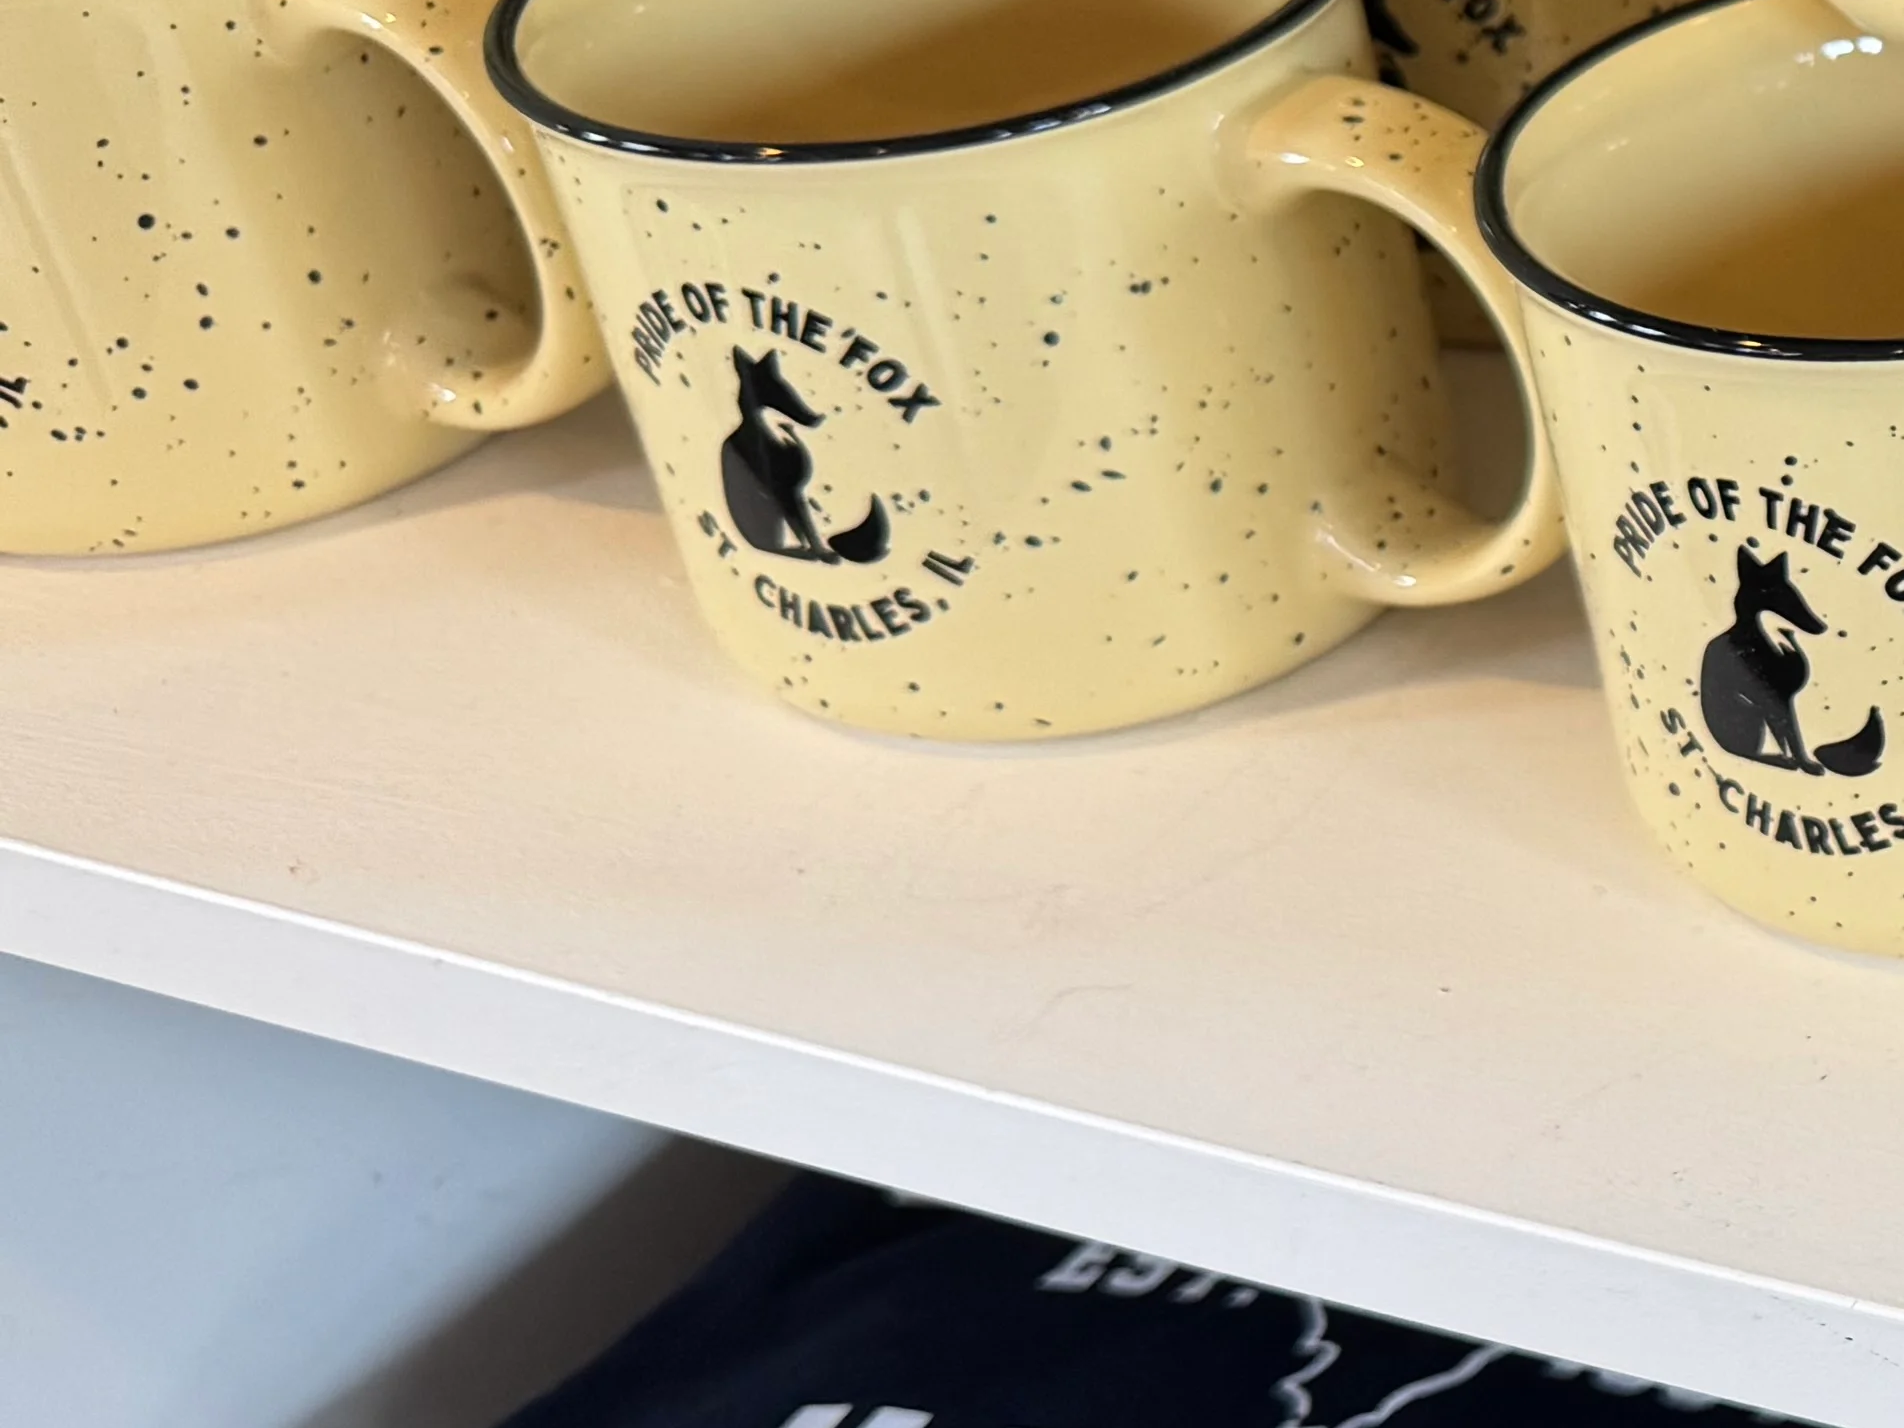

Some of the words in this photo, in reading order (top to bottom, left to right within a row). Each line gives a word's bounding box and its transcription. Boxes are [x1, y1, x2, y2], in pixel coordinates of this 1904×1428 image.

[631, 289, 685, 386] PRIDE
[681, 282, 729, 323] OF
[741, 287, 833, 353] THE
[839, 335, 940, 424] FOX
[921, 550, 975, 586] IL
[1613, 481, 1687, 578] PRIDE
[1687, 477, 1741, 521] OF
[1758, 486, 1856, 559] THE
